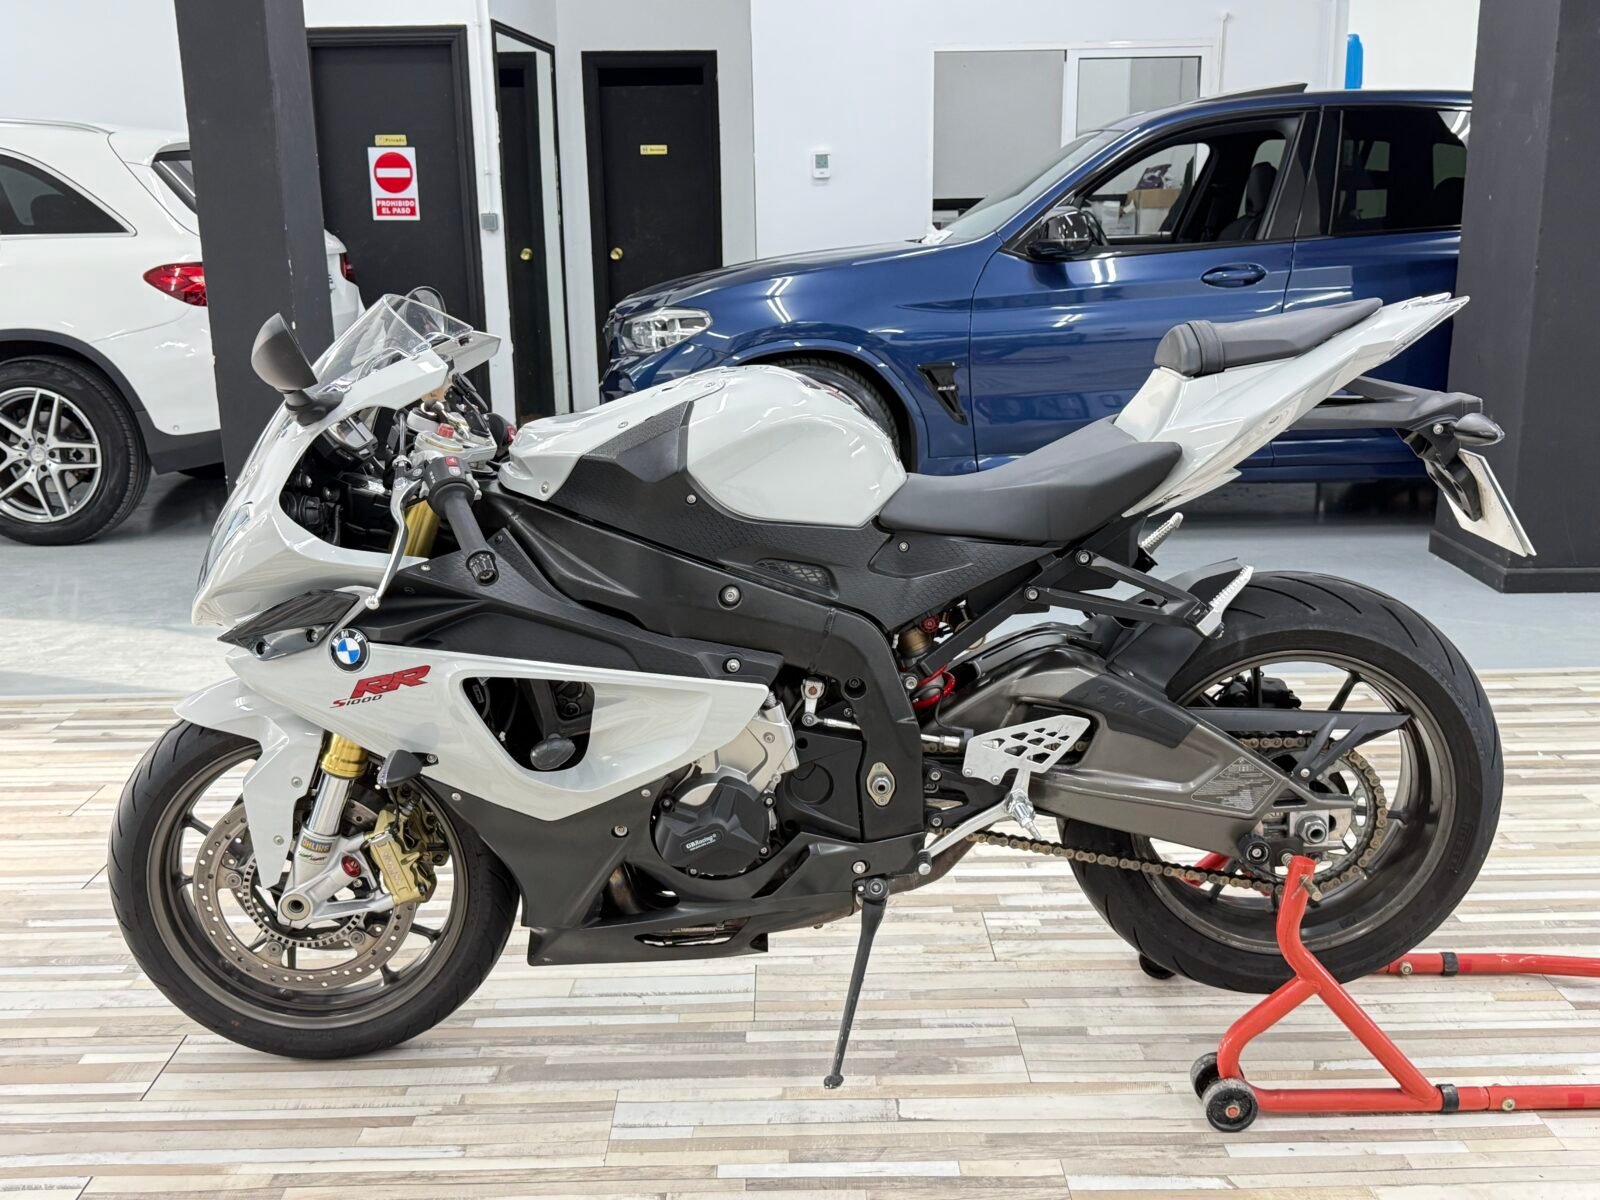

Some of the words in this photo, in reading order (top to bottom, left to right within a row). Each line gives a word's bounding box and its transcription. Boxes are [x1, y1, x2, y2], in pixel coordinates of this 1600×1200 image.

[331, 630, 364, 647] BMW
[350, 665, 431, 699] RR
[329, 694, 383, 709] S1000
